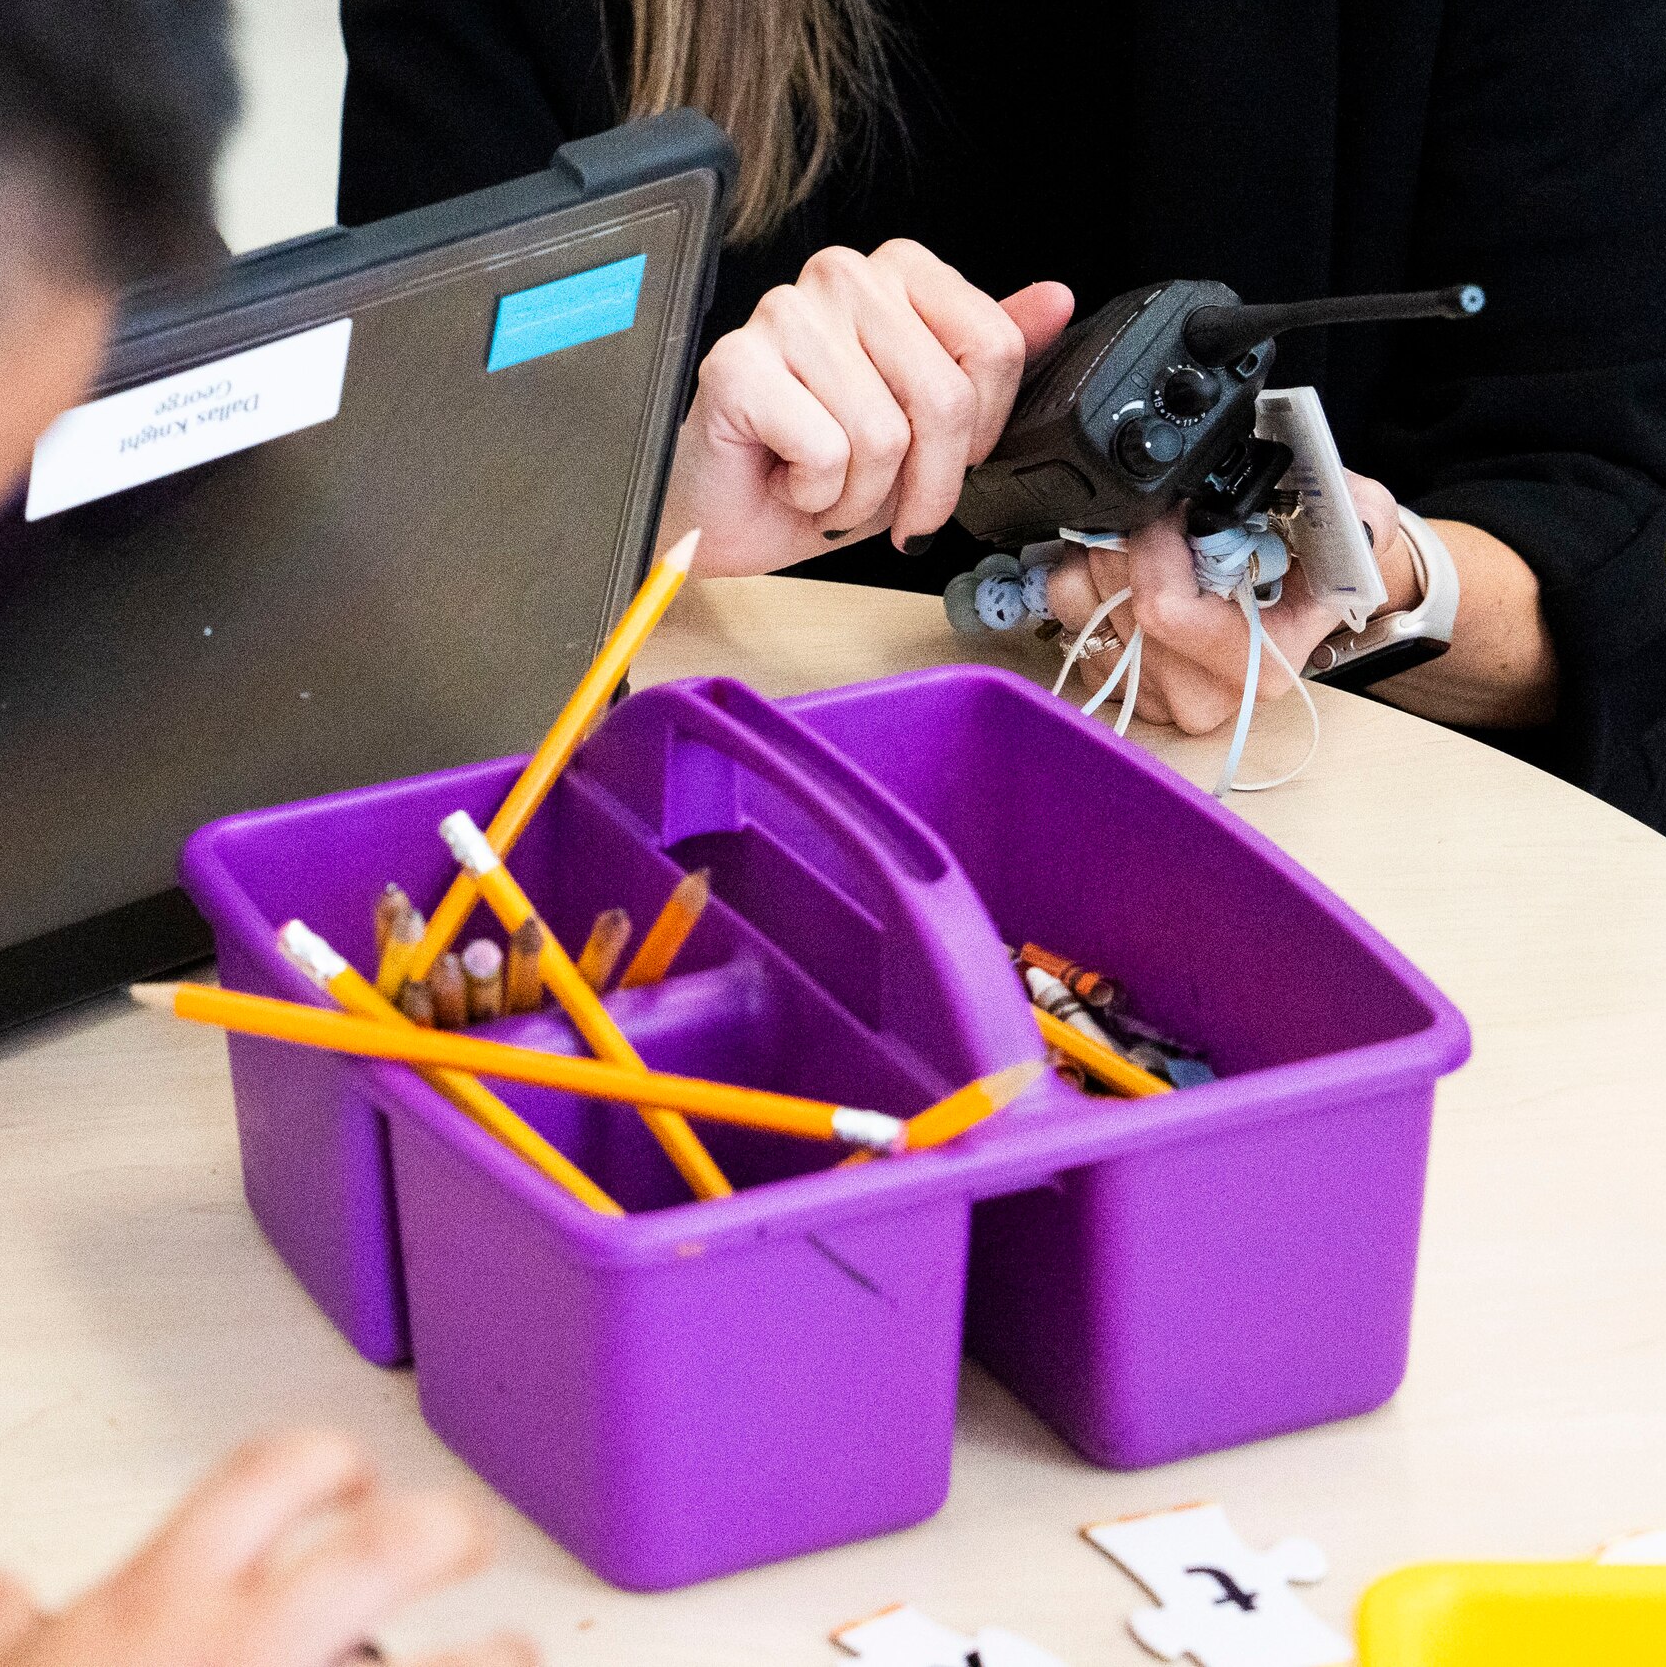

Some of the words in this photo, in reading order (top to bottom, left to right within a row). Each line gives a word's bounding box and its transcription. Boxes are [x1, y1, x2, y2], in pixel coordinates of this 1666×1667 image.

[154, 379, 233, 415] George
[197, 393, 259, 423] Dallas
[1153, 396, 1164, 408] 15
[118, 418, 189, 453] Knight
[1183, 418, 1192, 427] 11
